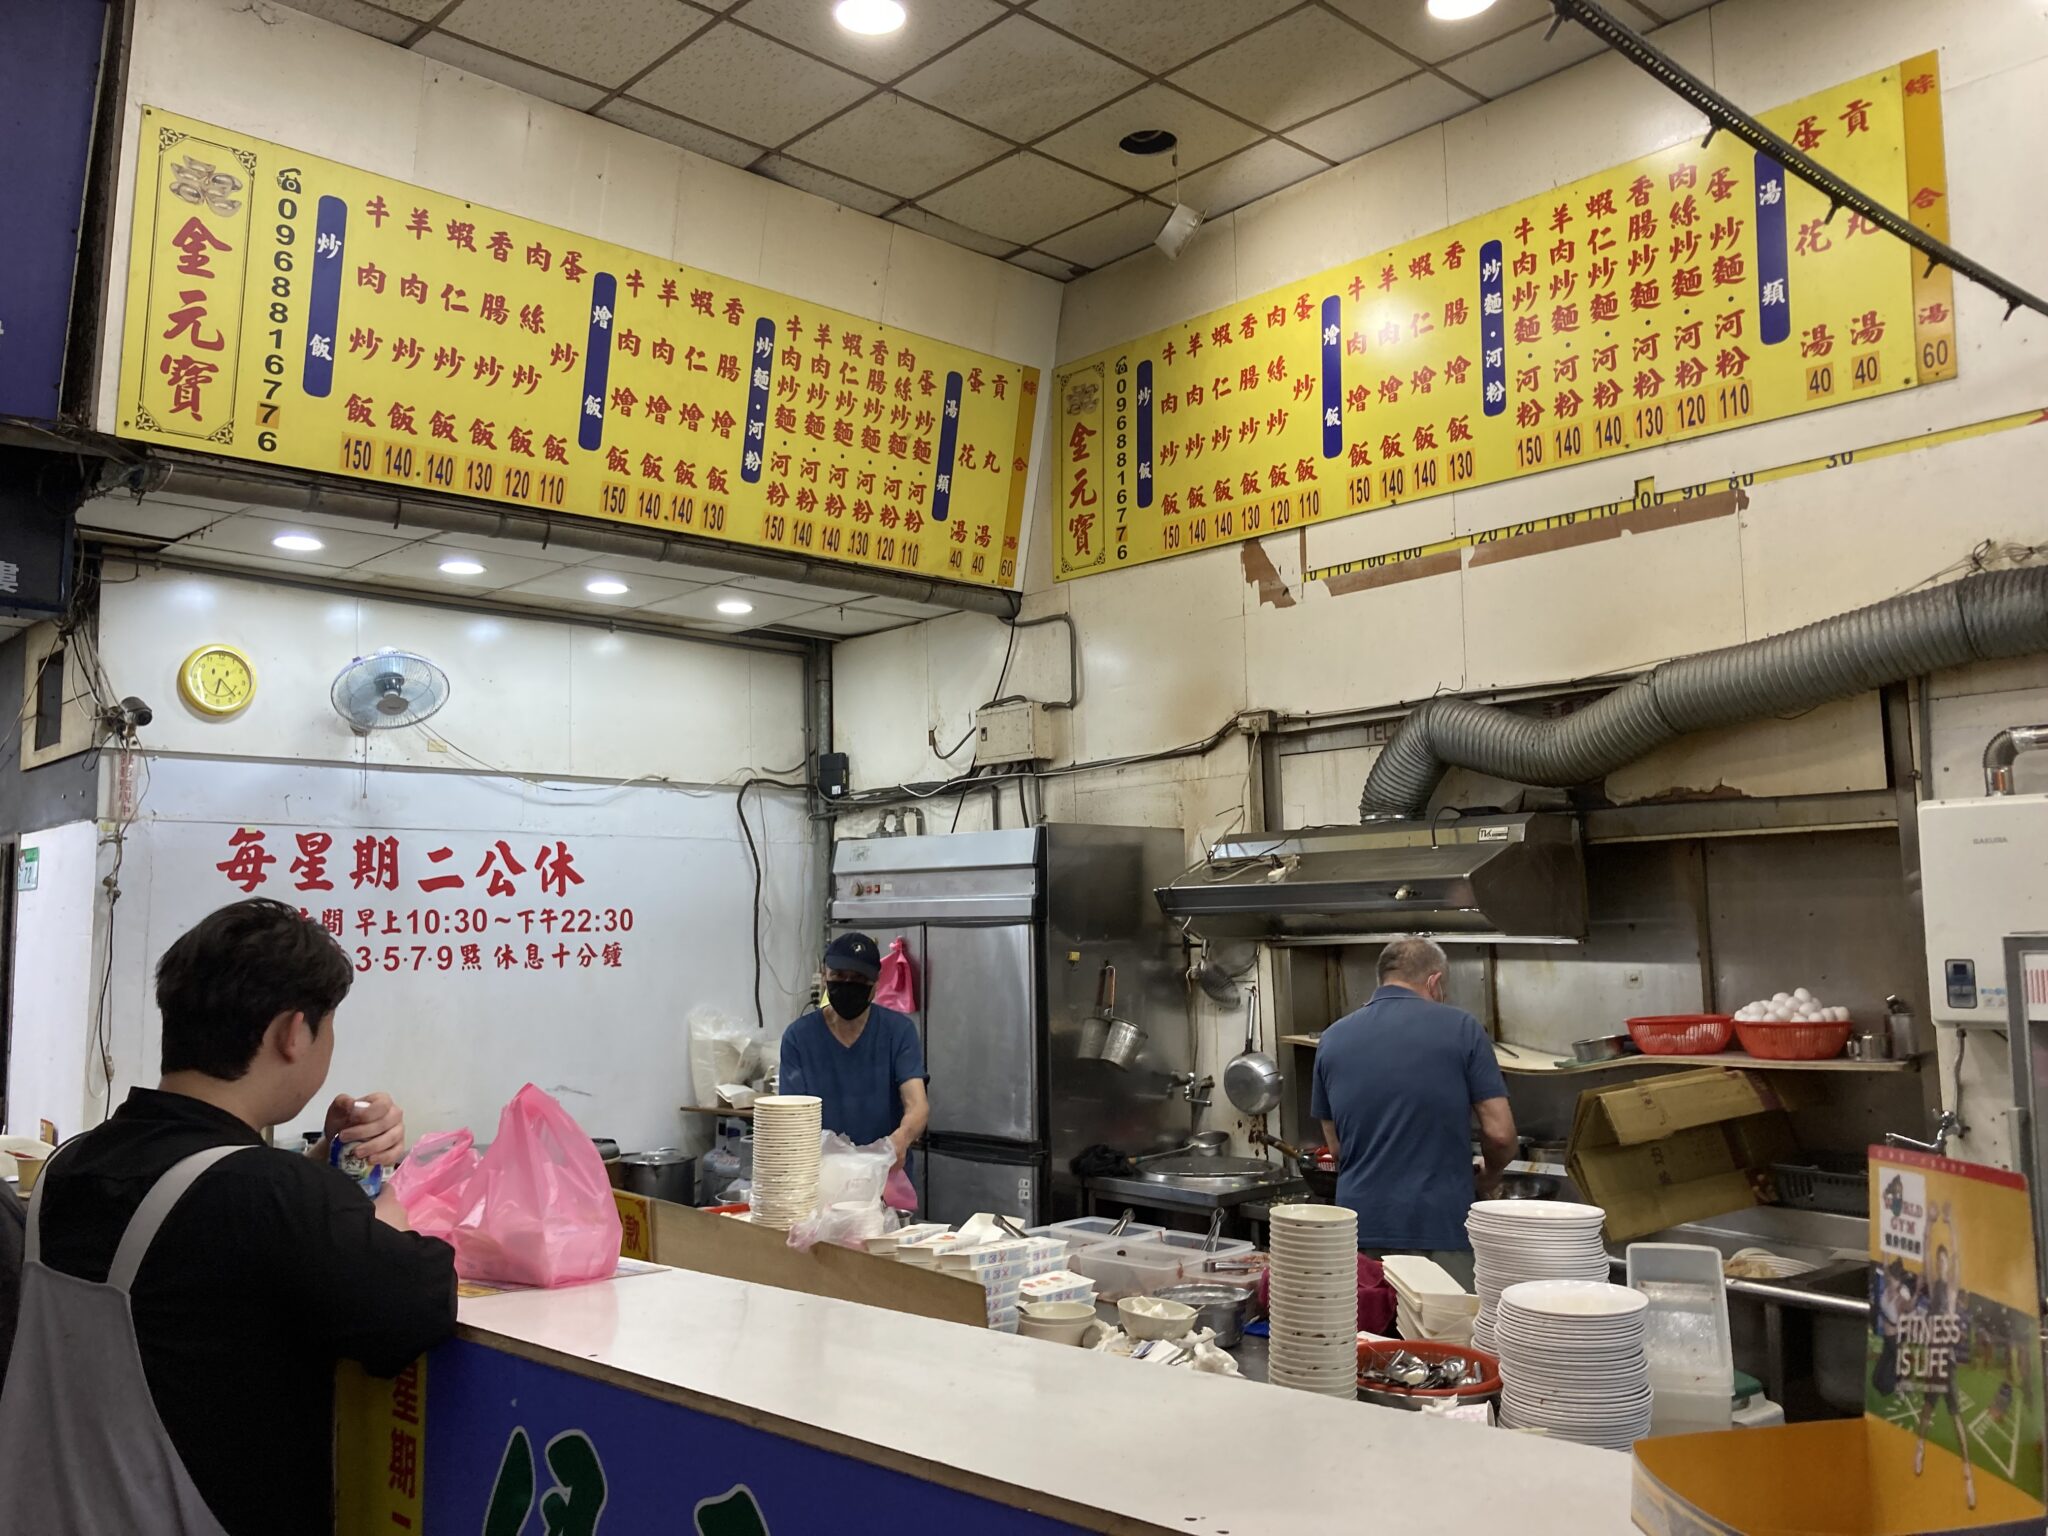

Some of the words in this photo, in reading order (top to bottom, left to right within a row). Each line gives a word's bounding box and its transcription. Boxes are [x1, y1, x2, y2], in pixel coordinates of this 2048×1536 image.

[159, 215, 233, 422] 金元寶
[257, 198, 297, 452] 0968816776
[309, 233, 342, 362] 炒飯
[344, 195, 393, 429] 牛肉炒飯
[387, 207, 434, 437] 羊肉炒飯
[1757, 178, 1787, 305] 湯類
[1791, 117, 1835, 357] 蛋花湯
[429, 220, 475, 443] 蝦仁炒飯
[468, 230, 514, 451] 香腸炒飯
[507, 240, 552, 459] 肉絲炒飯
[542, 249, 586, 466] 蛋炒飯
[606, 271, 647, 475] 牛肉燴飯
[640, 281, 680, 480] 羊肉燴飯
[673, 290, 715, 488] 蝦仁燴飯
[705, 299, 745, 493] 香腸燴飯
[1184, 334, 1207, 507] 羊肉炒飯
[1210, 323, 1234, 501] 蝦仁炒飯
[1237, 313, 1262, 495] 香腸炒飯
[1265, 305, 1290, 487] 肉絲炒飯
[1293, 293, 1318, 481] 蛋炒飯
[1343, 276, 1373, 466] 牛肉燴飯
[1374, 266, 1405, 459] 羊肉燴飯
[1408, 253, 1438, 450] 蝦仁燴飯
[1441, 241, 1473, 441] 香腸燴飯
[1809, 368, 1832, 394] 40
[1855, 357, 1878, 384] 40
[1922, 342, 1949, 369] 60
[344, 438, 371, 472] 150
[385, 447, 412, 479] 140
[427, 456, 454, 487] 140
[466, 463, 492, 493] 130
[505, 470, 530, 499] 120
[540, 477, 565, 506] 110
[603, 486, 626, 515] 150
[639, 495, 661, 522] 140
[672, 497, 693, 524] 140
[703, 505, 725, 532] 130
[935, 398, 960, 494] 湯類
[949, 370, 985, 542] 蛋花湯
[974, 375, 1009, 547] 貢丸湯
[1067, 421, 1097, 556] 金元寶
[1115, 378, 1128, 561] 0968816776
[1137, 386, 1153, 479] 炒飯
[1159, 343, 1180, 515] 牛肉炒飯
[1349, 476, 1370, 504] 150
[1381, 469, 1404, 496] 140
[1413, 460, 1437, 488] 140
[1449, 451, 1473, 481] 130
[1518, 436, 1543, 466] 150
[1555, 427, 1581, 457] 140
[1594, 416, 1622, 448] 140
[1635, 406, 1664, 437] 130
[1677, 394, 1706, 427] 120
[1719, 384, 1750, 418] 110
[765, 515, 784, 542] 150
[793, 522, 812, 548] 140
[821, 527, 841, 553] 140
[850, 533, 869, 557] 130
[876, 537, 894, 562] 120
[901, 542, 919, 567] 110
[950, 551, 962, 569] 40
[972, 556, 984, 574] 40
[1001, 559, 1013, 577] 60
[1163, 525, 1180, 550] 150
[1188, 519, 1207, 544] 140
[1214, 514, 1233, 538] 140
[1241, 507, 1260, 531] 130
[1271, 499, 1290, 526] 120
[1299, 490, 1320, 518] 110
[215, 827, 585, 898] 每星期二公休
[494, 942, 623, 971] 休息十分鐘
[1896, 1347, 1911, 1378] IS
[1914, 1347, 1949, 1378] LIFE
[1897, 1314, 1961, 1345] FITNESS
